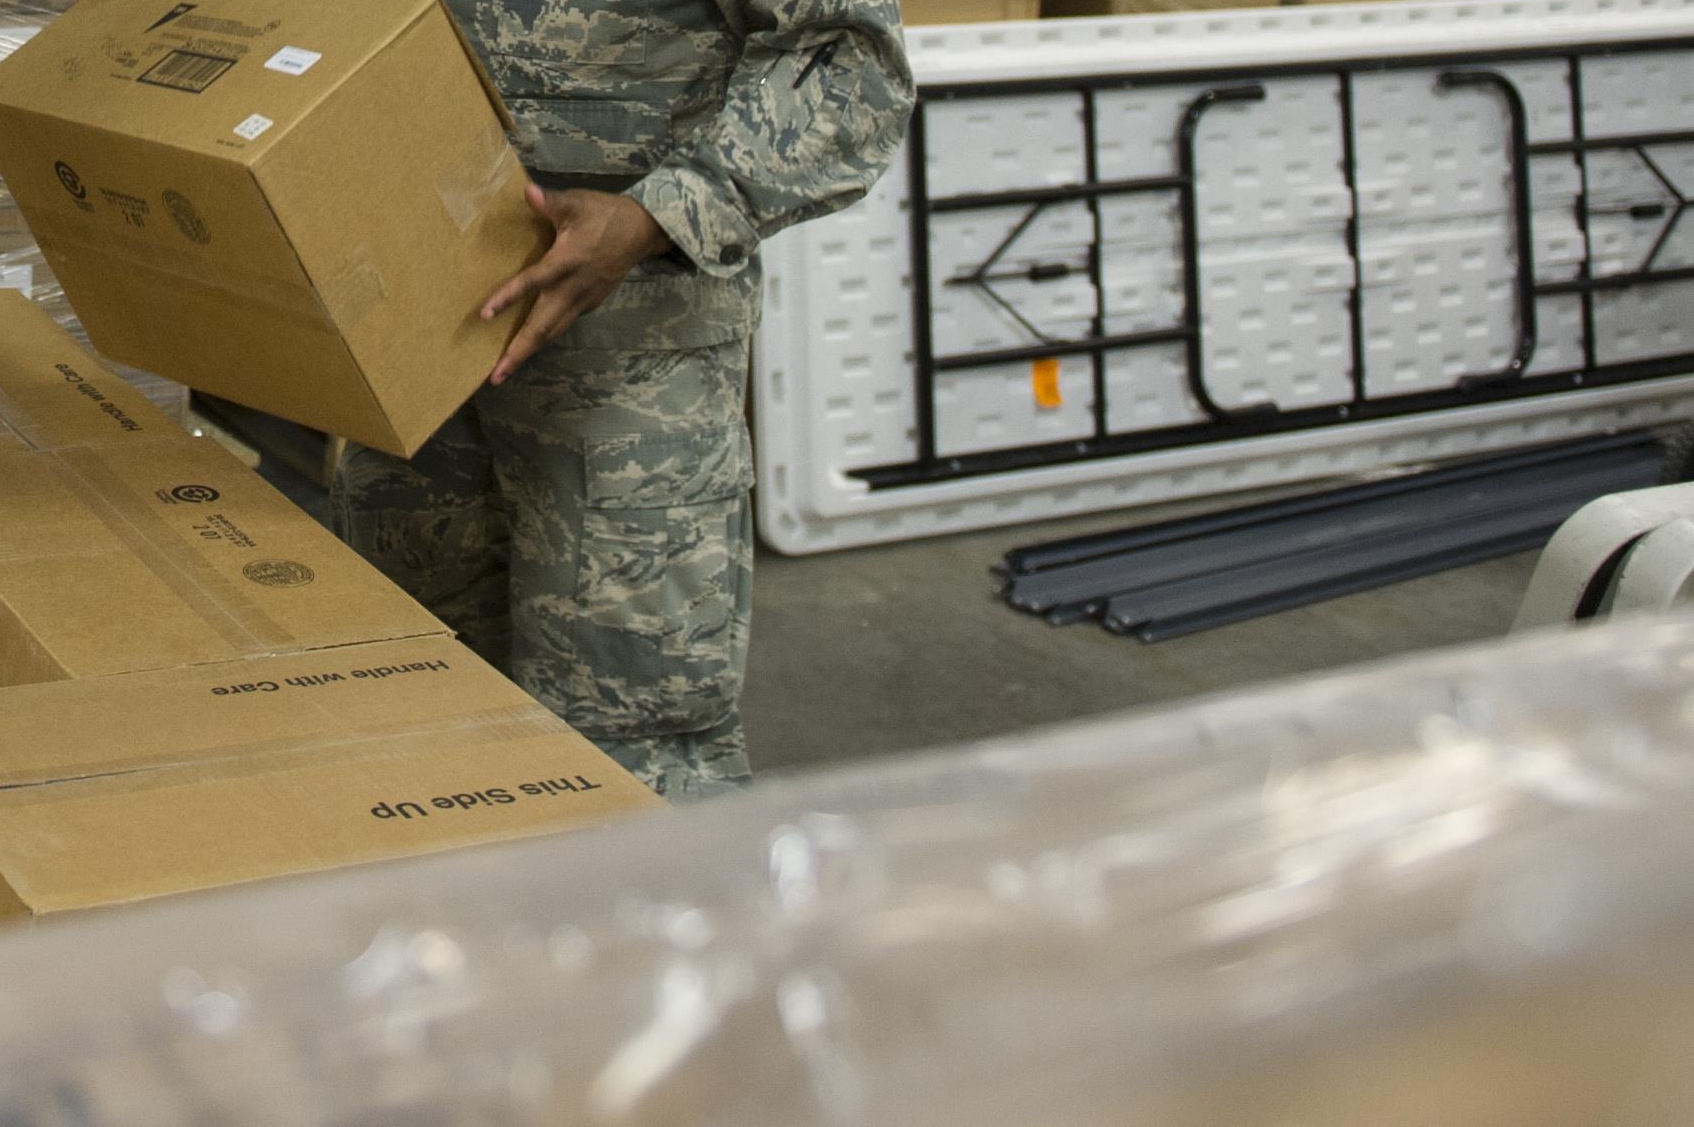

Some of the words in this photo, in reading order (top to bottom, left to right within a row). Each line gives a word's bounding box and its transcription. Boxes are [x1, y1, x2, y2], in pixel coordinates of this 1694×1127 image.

[55, 363, 83, 382] Care
[77, 381, 105, 402] with
[100, 402, 143, 432] Handle
[283, 671, 344, 688] with
[349, 659, 451, 680] Handle
[211, 680, 280, 697] Care
[518, 775, 603, 798] This
[430, 788, 517, 812] Side
[370, 801, 429, 821] Up
